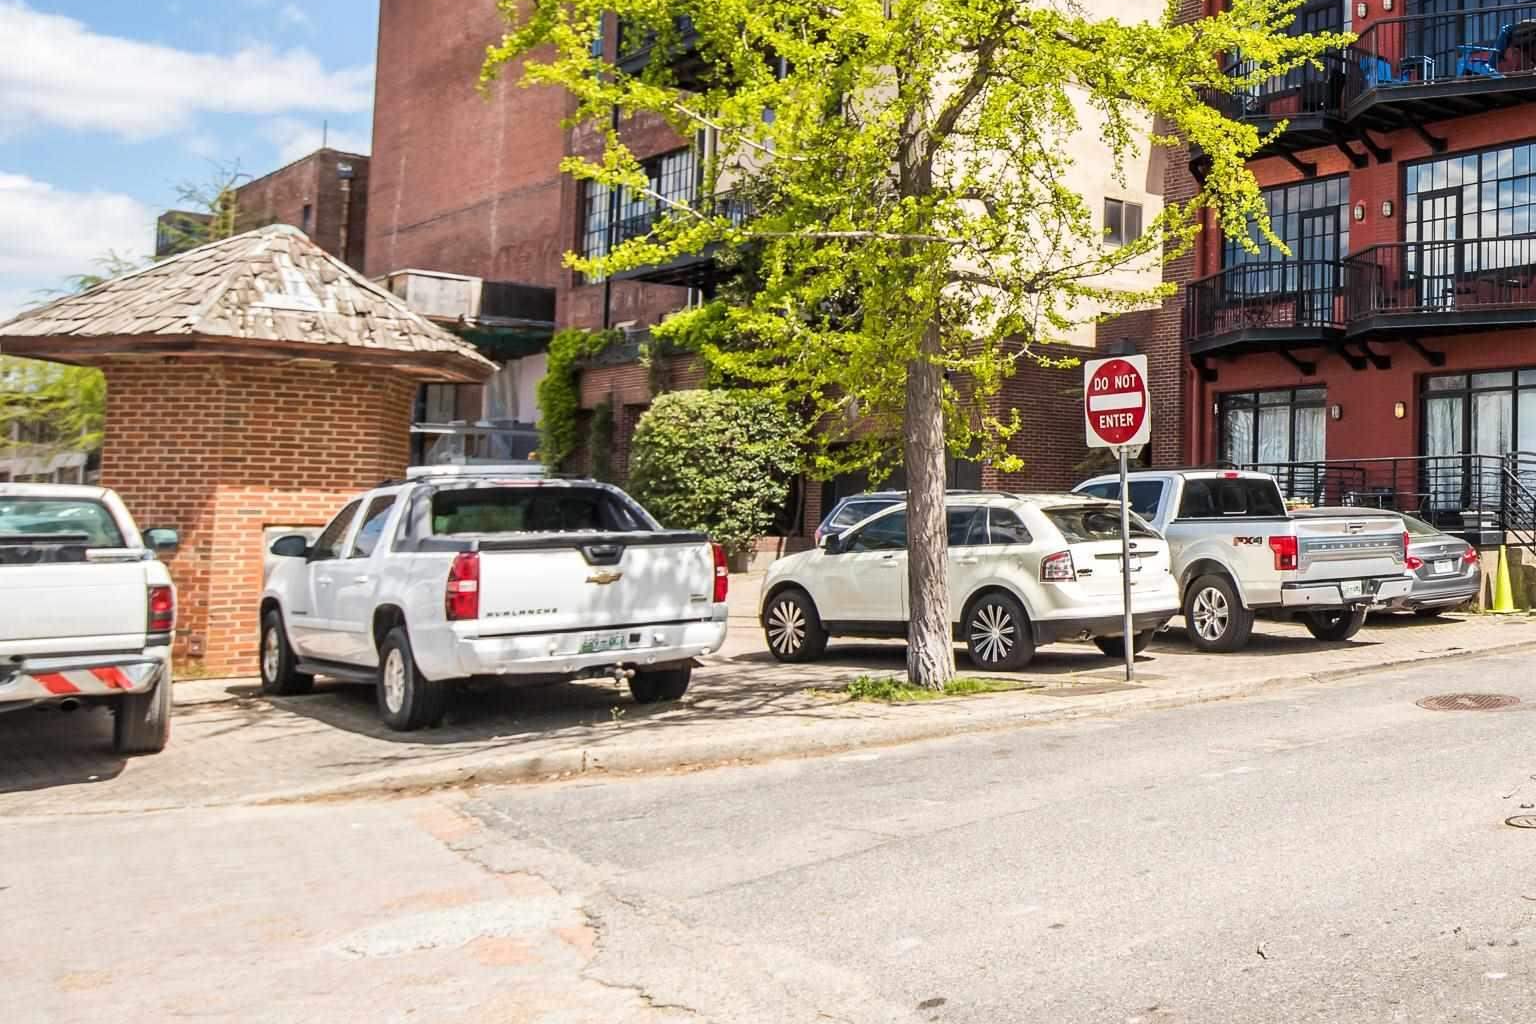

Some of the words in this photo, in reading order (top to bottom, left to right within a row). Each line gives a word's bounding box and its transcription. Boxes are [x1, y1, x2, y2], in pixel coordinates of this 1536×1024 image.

[1094, 376, 1109, 391] DO
[1115, 373, 1137, 389] NOT
[1099, 412, 1134, 429] ENTER
